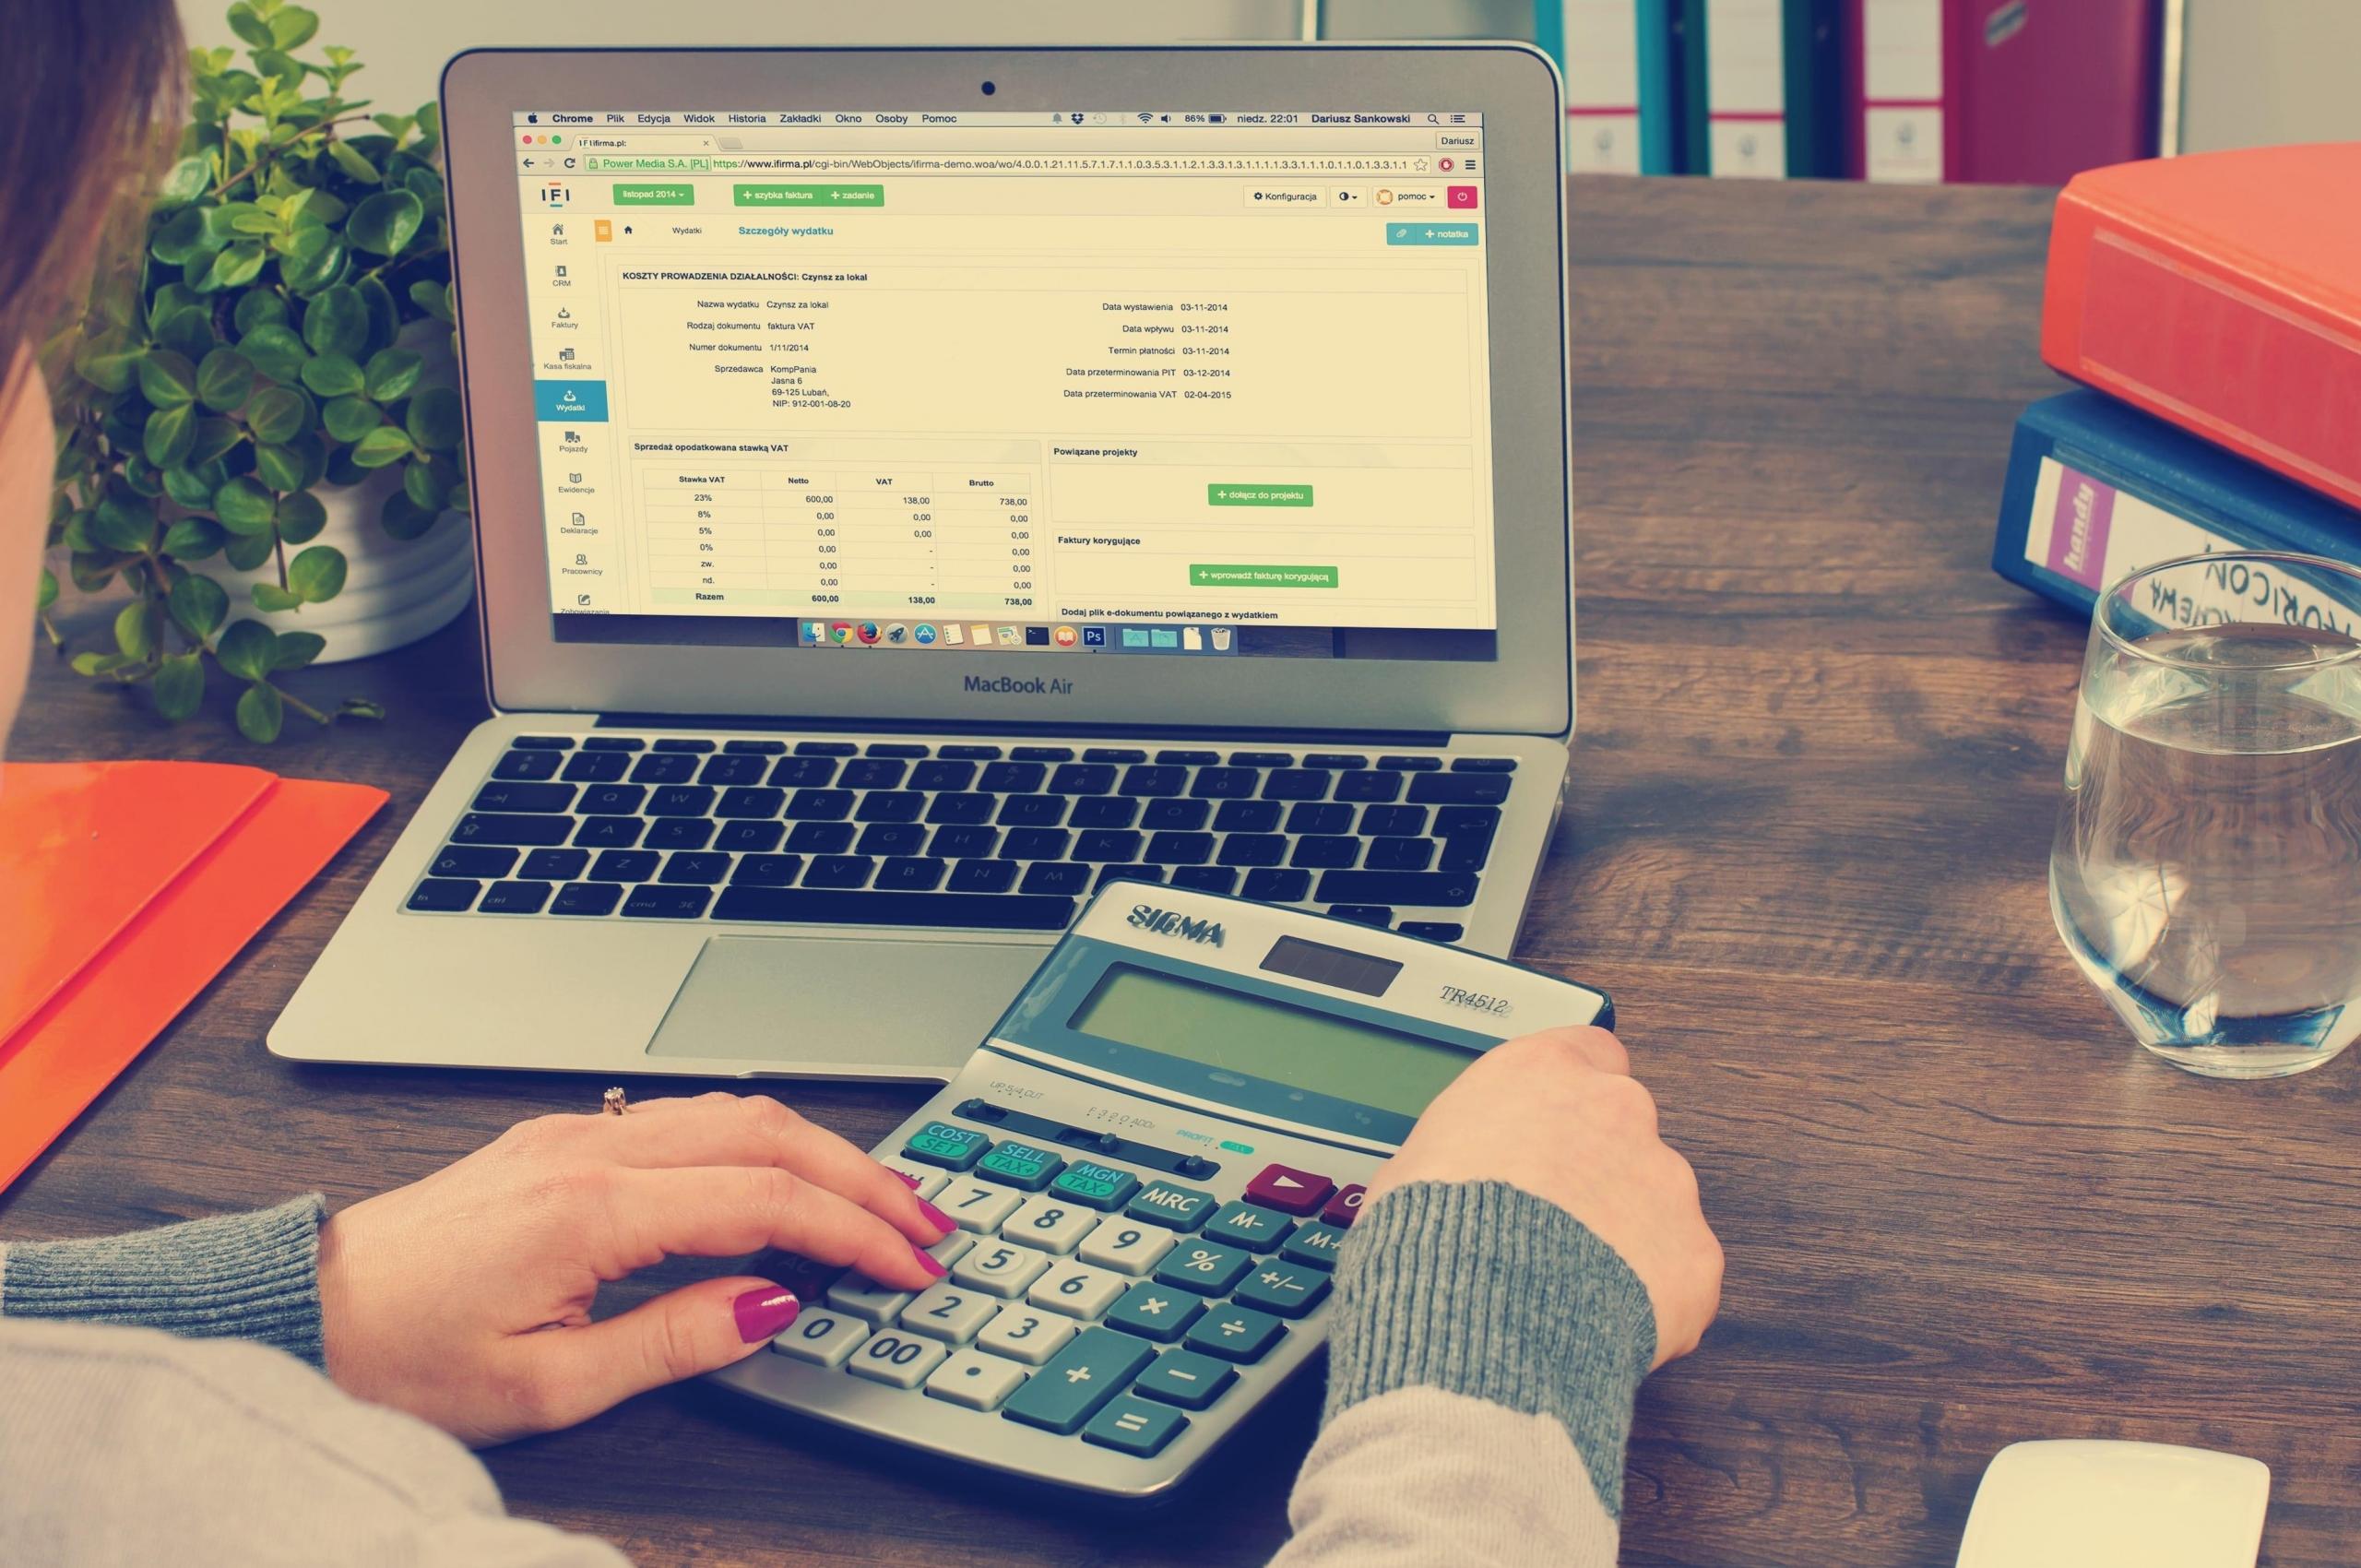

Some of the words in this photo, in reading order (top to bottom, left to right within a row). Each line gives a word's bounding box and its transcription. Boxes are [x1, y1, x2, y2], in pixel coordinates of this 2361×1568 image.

[552, 114, 593, 123] Chrome
[607, 114, 624, 123] Plik
[637, 114, 670, 125] Edycja
[684, 114, 715, 123] Widok
[729, 114, 766, 123] Historia
[780, 114, 821, 123] Zakładki
[835, 114, 861, 123] Okno
[875, 114, 908, 125] Osoby
[922, 114, 957, 123] Pomoc
[1184, 114, 1204, 123] 86%
[1238, 114, 1267, 123] niedz.
[1271, 114, 1298, 123] 22:01
[1311, 114, 1351, 123] Dariusz
[1354, 114, 1410, 123] Sankowski
[1442, 137, 1474, 146] Dariusz
[603, 160, 633, 168] Power
[635, 160, 665, 168] Media
[669, 160, 687, 168] S.A.
[690, 160, 708, 170] [PL]
[623, 190, 654, 200] listopad
[755, 191, 783, 200] szybka
[785, 191, 813, 199] faktura
[842, 191, 874, 199] zadanie
[1265, 193, 1317, 202] Konfiguracja
[672, 227, 702, 235] Wydatki
[739, 226, 789, 236] Szczegóły
[792, 227, 834, 236] wydatku
[1438, 230, 1468, 238] notatka
[623, 272, 658, 280] KOSZTY
[661, 272, 728, 280] PROWADZENIA
[730, 271, 799, 280] DZIAŁALNOŚCI:
[801, 273, 833, 282] Czynsz
[727, 301, 759, 310] wydatku
[766, 301, 796, 310] Czynsz
[810, 301, 829, 309] lokal
[1123, 303, 1173, 312] wystawienia
[552, 321, 578, 329] Faktury
[687, 322, 715, 331] Rodzaj
[717, 322, 761, 330] dokumentu
[1144, 326, 1174, 334] wpływu
[1139, 347, 1175, 356] płatności
[715, 365, 764, 374] Sprzedawca
[770, 365, 817, 374] KompPania
[1087, 369, 1159, 377] przeterminowania
[1086, 390, 1157, 399] przeterminowania
[556, 404, 586, 412] Wydatki
[559, 445, 588, 454] Pojazdy
[635, 443, 673, 452] Sprzedaż
[675, 444, 737, 452] opodatkowana
[739, 444, 768, 453] stawką
[1053, 448, 1100, 457] Powiązane
[1102, 448, 1137, 457] projekty
[558, 486, 595, 494] Ewidencje
[806, 495, 833, 504] 600,00
[1229, 491, 1256, 500] dołącz
[1271, 491, 1304, 501] projektu
[903, 497, 930, 505] 138,00
[1000, 498, 1027, 506] 738,00
[816, 512, 835, 520] 0,00
[561, 527, 599, 535] Deklaracje
[2064, 483, 2094, 572] handy
[1058, 537, 1091, 545] Faktury
[1093, 537, 1141, 546] korygujące
[1253, 572, 1282, 581] fakturę
[1285, 572, 1329, 582] korygującą
[812, 595, 839, 603] 600,00
[1004, 598, 1032, 606] 738,00
[1062, 609, 1086, 617] Dodaj
[1089, 609, 1104, 617] plik
[1107, 609, 1163, 617] e-dokumentu
[1166, 610, 1223, 619] powiązanego
[1232, 611, 1278, 621] wydatkiem
[1086, 631, 1101, 641] Ps
[964, 675, 1046, 694] MacBook
[1050, 677, 1074, 695] Air
[603, 793, 617, 802] Q
[1127, 905, 1223, 944] SIGMA
[1440, 986, 1508, 1013] TR4512
[928, 1124, 980, 1144] COST
[920, 1138, 958, 1154] SET
[1002, 1144, 1049, 1163] SELL
[990, 1156, 1034, 1175] TAX+
[1077, 1164, 1124, 1182] MGN
[1064, 1176, 1107, 1194] TAX-
[958, 1189, 992, 1207] 7
[1142, 1188, 1200, 1212] MRC
[1034, 1209, 1064, 1229] 8
[1228, 1211, 1264, 1229] M-
[1112, 1230, 1141, 1249] 9
[982, 1249, 1015, 1269] 5
[1060, 1276, 1089, 1294] 6
[929, 1296, 962, 1318] 2
[803, 1318, 835, 1339] 0
[1008, 1318, 1039, 1338] 3
[869, 1337, 921, 1364] 00
